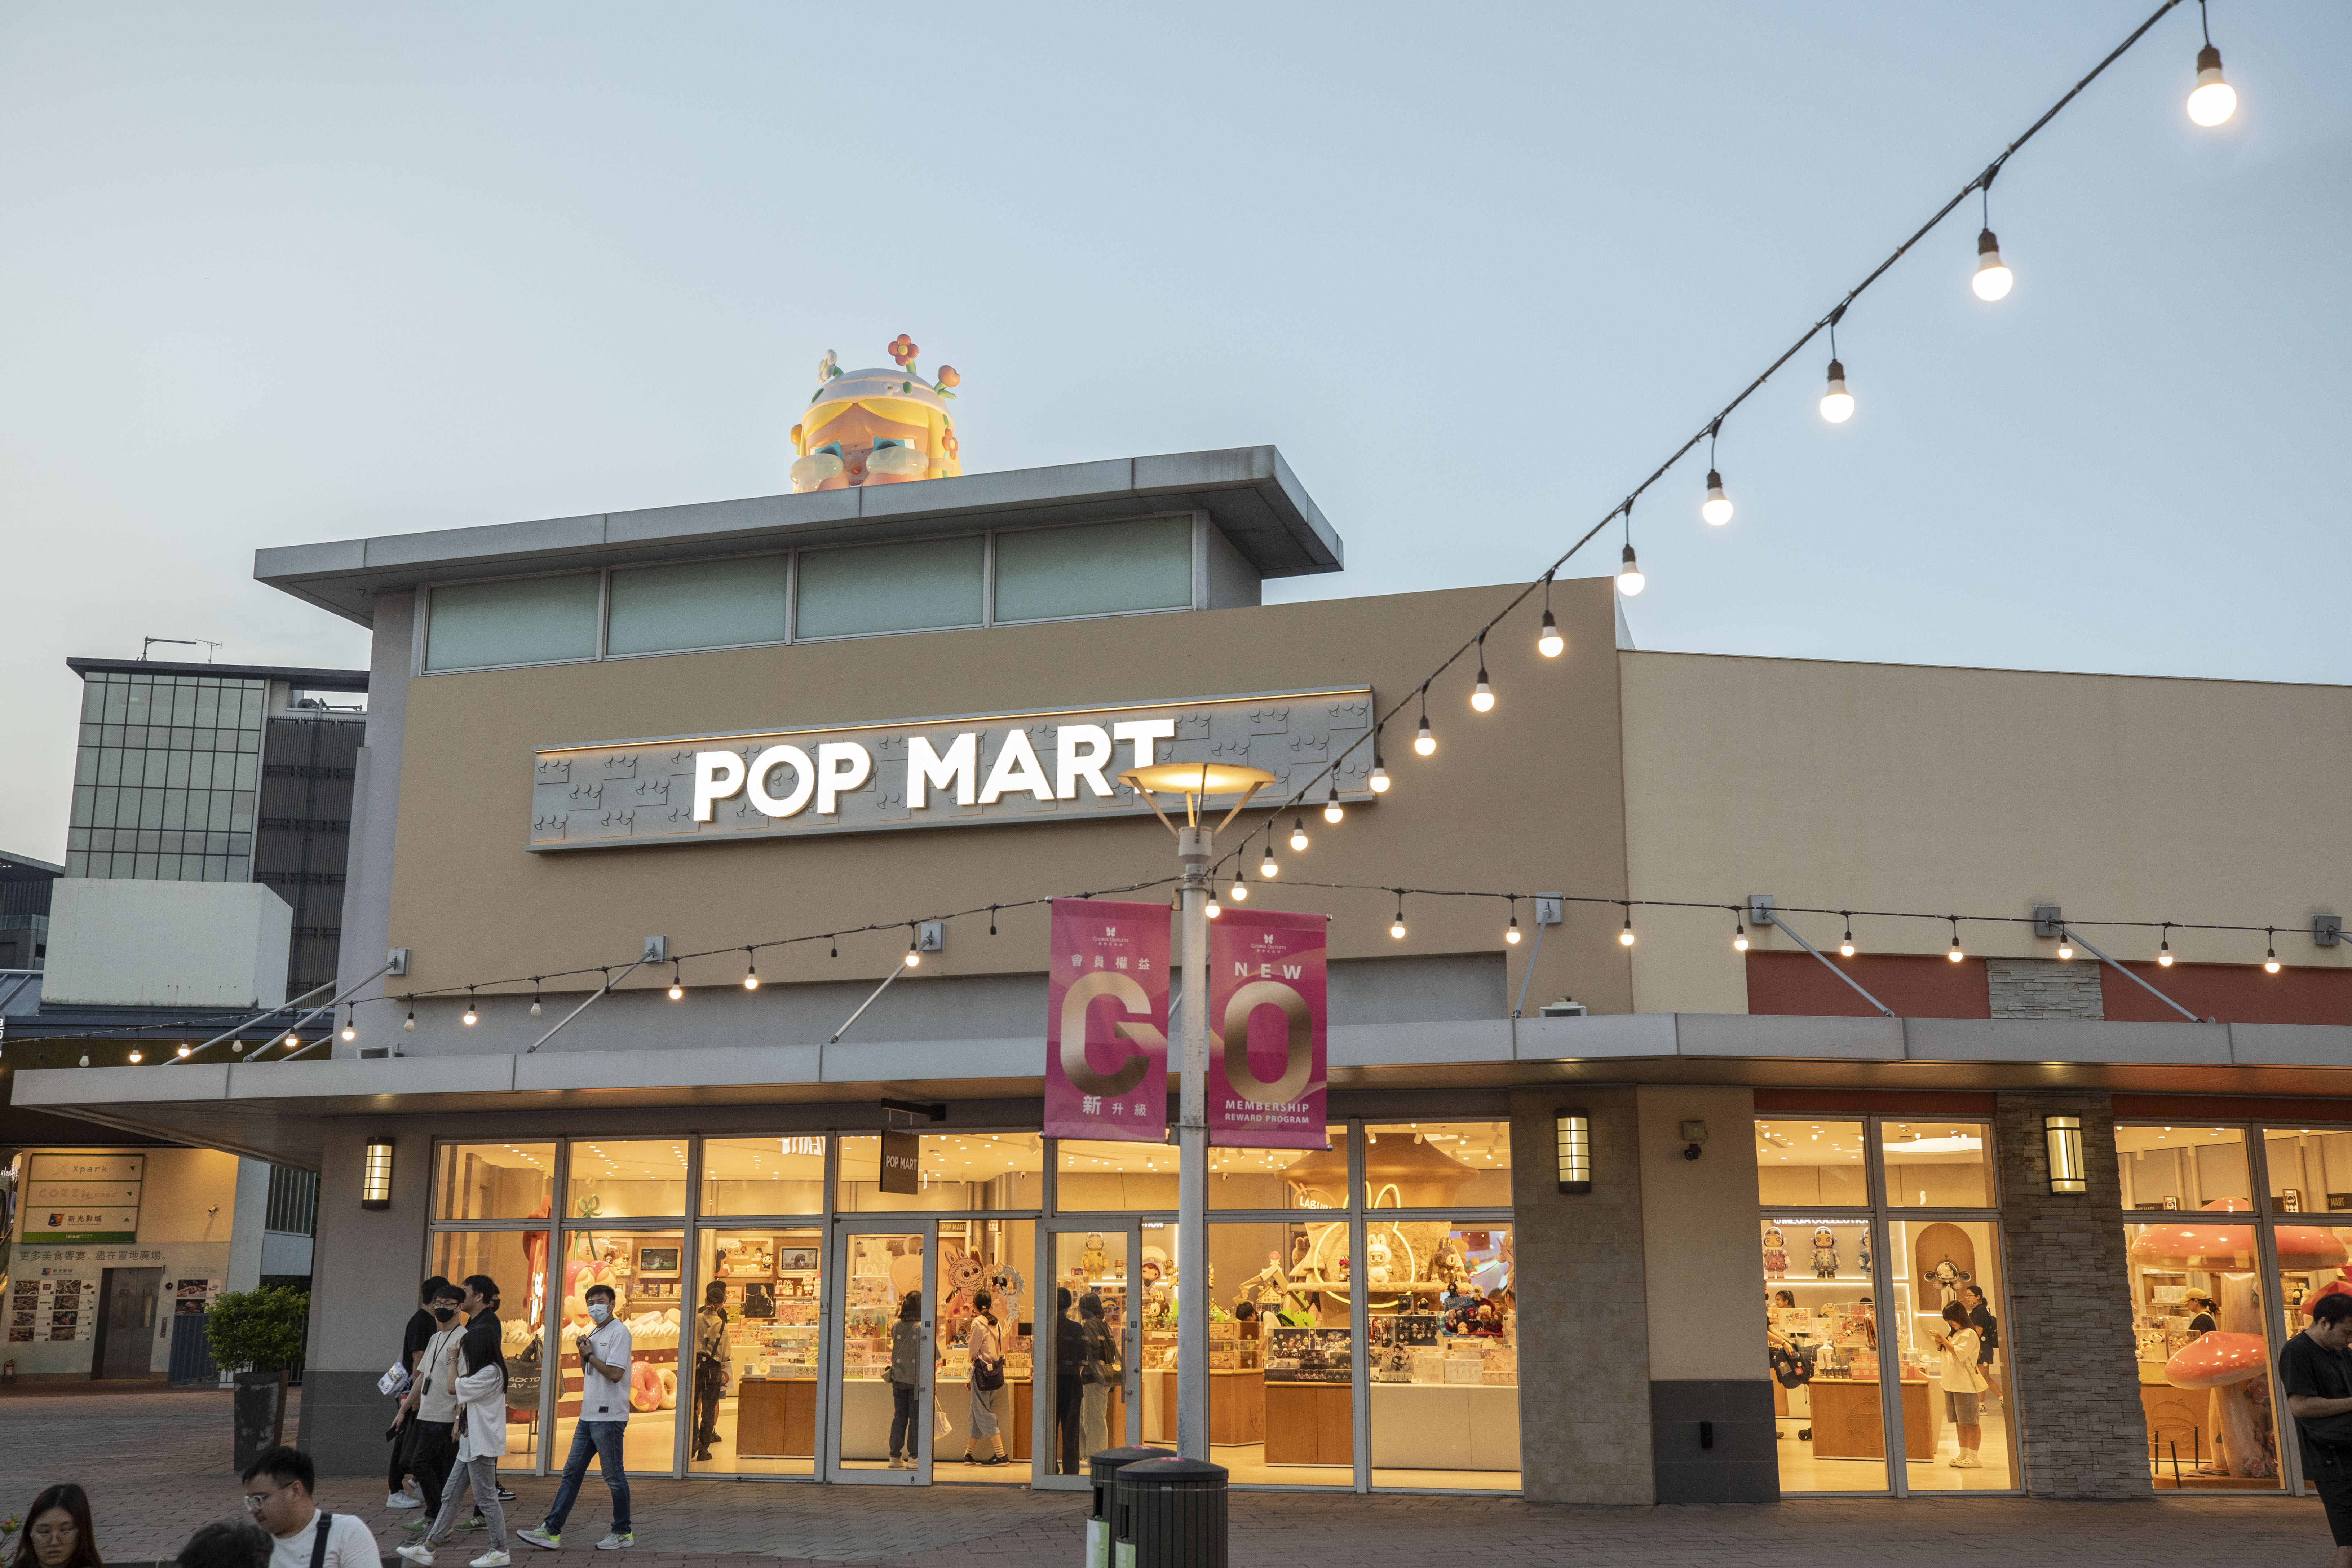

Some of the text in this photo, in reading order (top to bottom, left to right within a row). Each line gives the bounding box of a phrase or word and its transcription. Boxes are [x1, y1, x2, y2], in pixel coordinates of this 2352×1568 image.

[693, 718, 1175, 822] POP MART
[1071, 954, 1150, 971] 會員權益
[1235, 962, 1302, 980] NEW
[1060, 972, 1159, 1097] G
[1224, 981, 1312, 1105] O
[1083, 1095, 1146, 1116] 新升級
[1225, 1100, 1309, 1112] MEMBERSHIP
[1225, 1113, 1309, 1123] REWARD PROGRAM
[886, 1155, 918, 1170] POP MART
[2330, 1197, 2344, 1207] MART
[19, 1250, 166, 1261] 更多美食饗宴、盡在置地廣場。
[867, 1252, 892, 1264] FOR
[857, 1263, 890, 1275] LOVE
